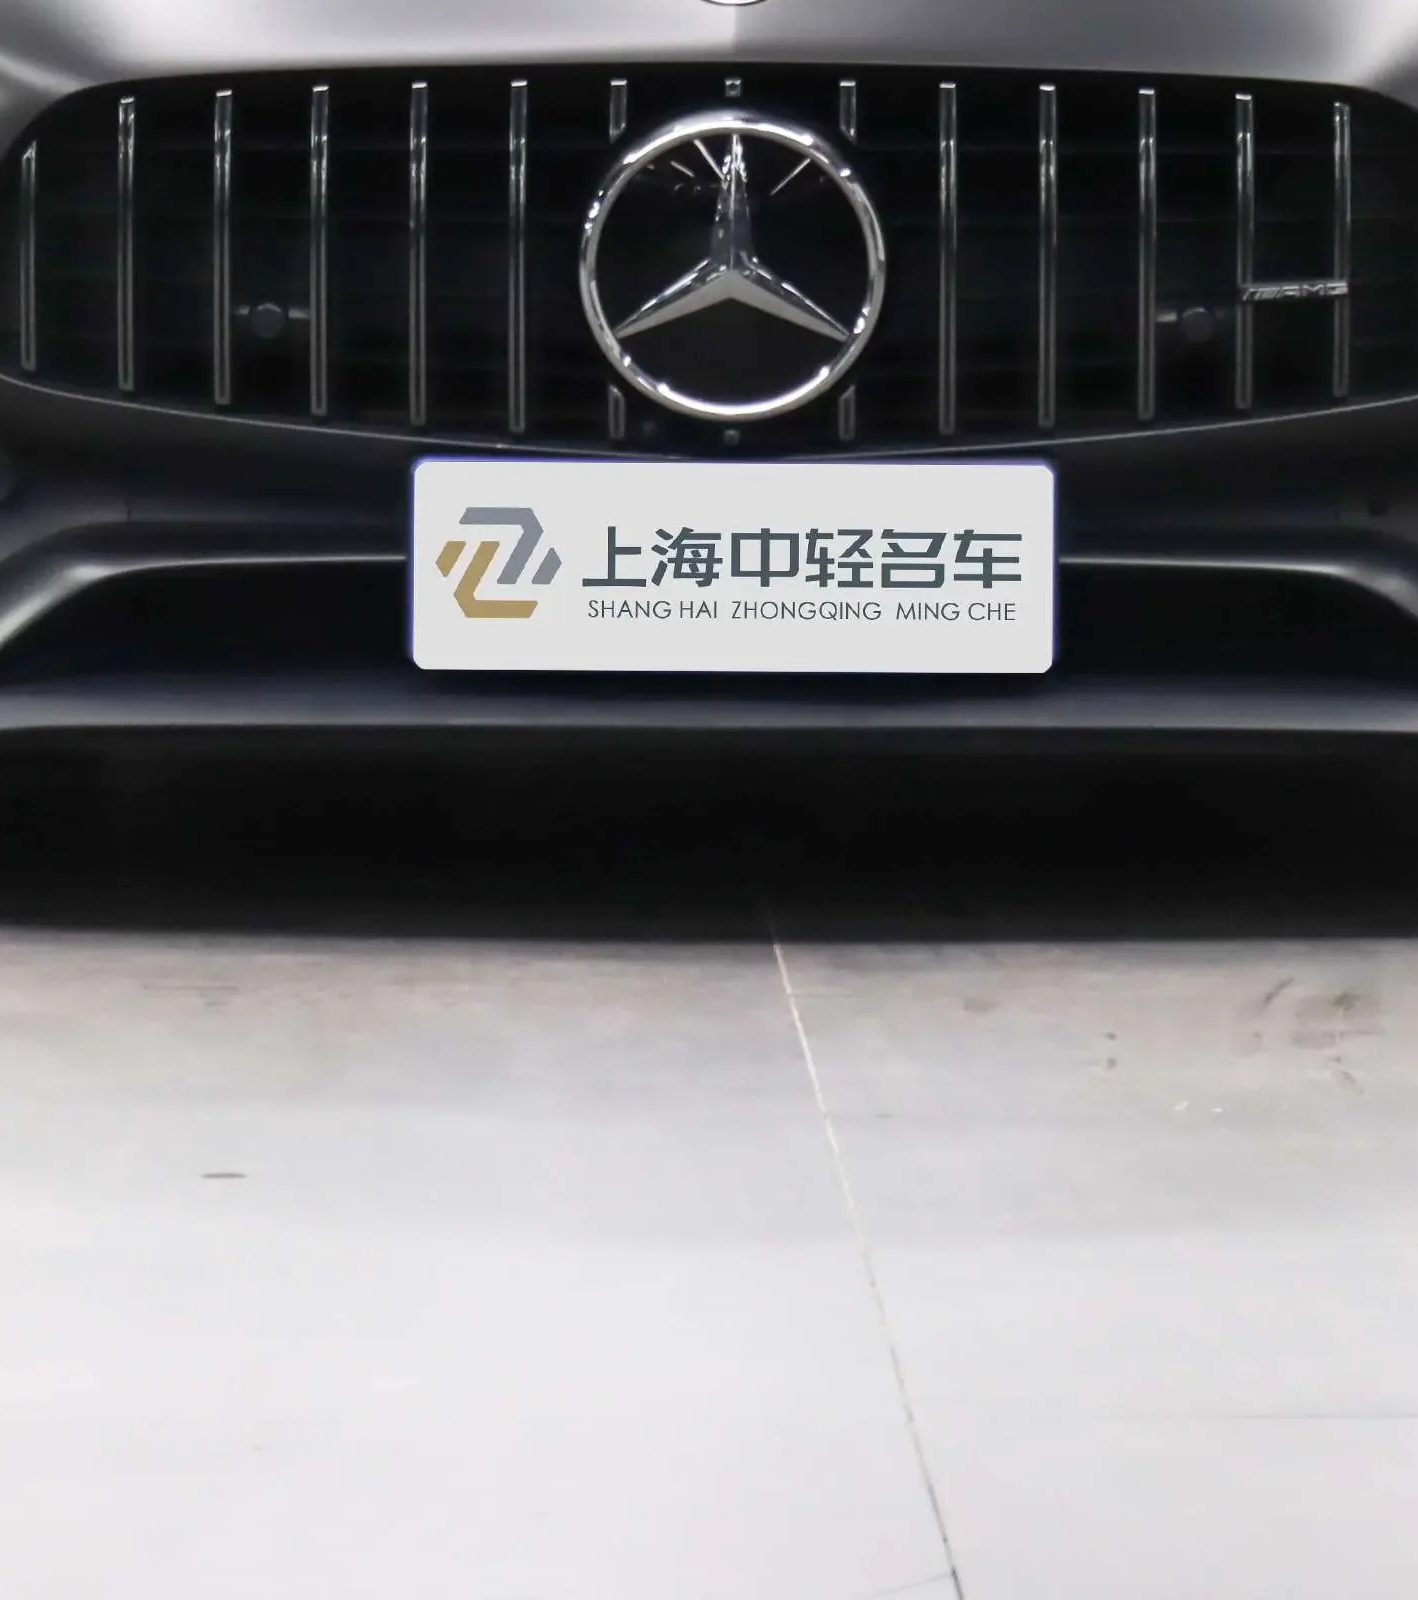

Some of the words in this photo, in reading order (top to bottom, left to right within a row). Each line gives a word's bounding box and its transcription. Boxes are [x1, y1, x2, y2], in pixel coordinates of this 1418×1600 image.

[581, 525, 1023, 589] 上海中轻名车
[587, 599, 672, 620] SHANG
[679, 600, 718, 620] HAI
[730, 600, 882, 622] ZHONGQING
[895, 602, 961, 622] MING
[967, 602, 1017, 622] CHE
